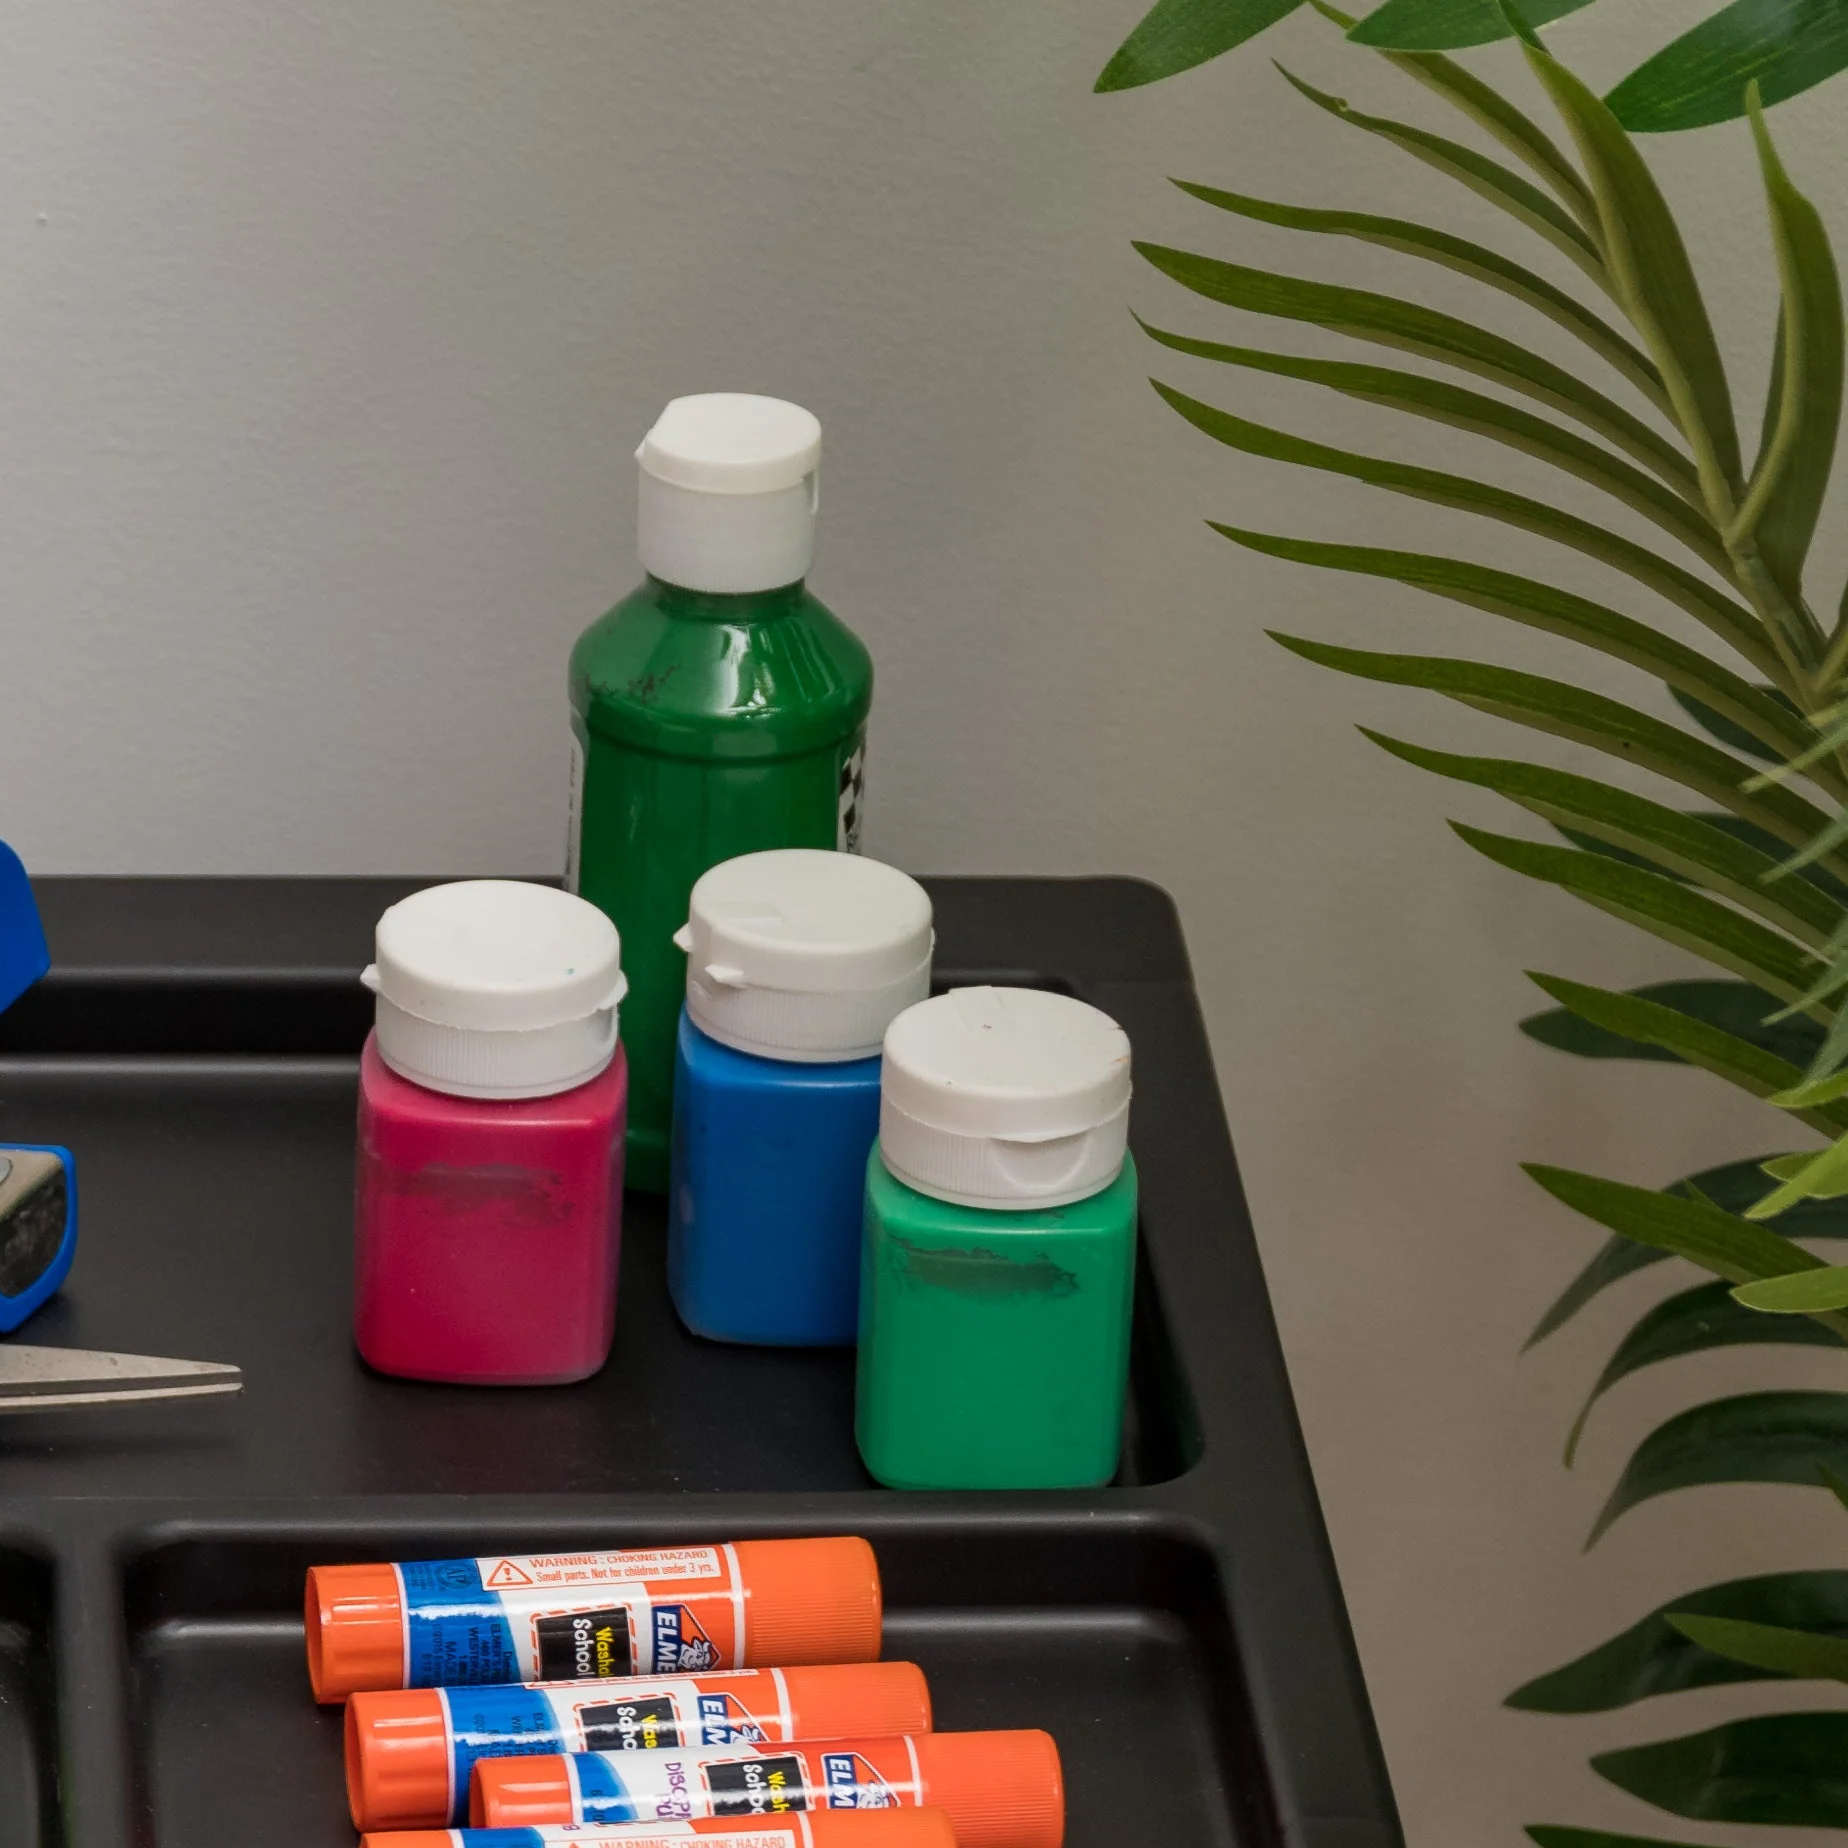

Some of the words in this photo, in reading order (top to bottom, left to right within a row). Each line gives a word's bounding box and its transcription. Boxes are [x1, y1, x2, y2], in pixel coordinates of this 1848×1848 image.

[607, 1553, 657, 1564] CHOKING
[660, 1550, 708, 1561] HAZARD
[536, 1570, 561, 1582] Small
[591, 1567, 608, 1579] Not
[624, 1564, 659, 1577] children
[688, 1562, 696, 1573] 3
[829, 1758, 854, 1806] ELM
